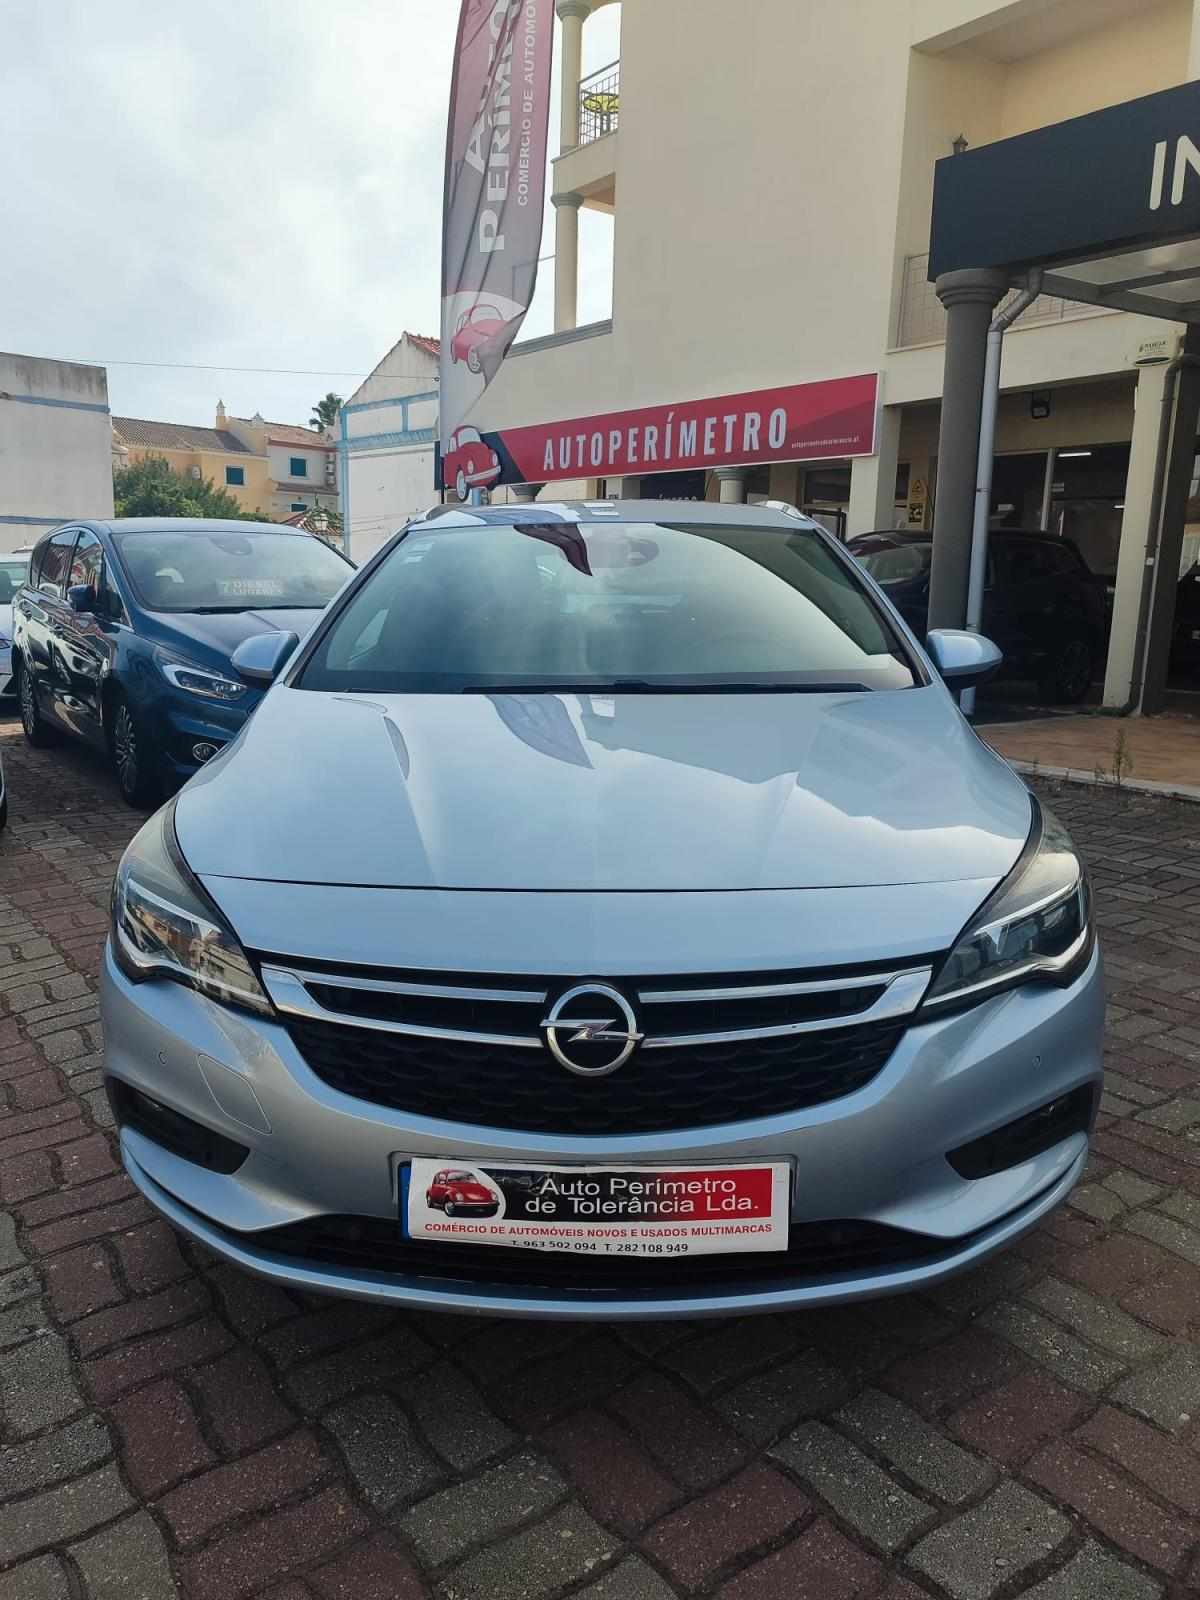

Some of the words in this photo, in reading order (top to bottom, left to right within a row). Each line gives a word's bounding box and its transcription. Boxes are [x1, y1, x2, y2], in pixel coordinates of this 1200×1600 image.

[522, 91, 534, 113] DE
[518, 119, 532, 207] COMERCIO
[543, 408, 788, 471] AUTOPERÍMETRO
[540, 1178, 600, 1196] Auto
[610, 1178, 737, 1196] Perímetro
[525, 1197, 557, 1214] de
[567, 1196, 695, 1215] Tolerância
[706, 1195, 759, 1212] Lda.
[424, 1222, 487, 1234] COMÉRCIO
[490, 1226, 505, 1235] DE
[508, 1224, 584, 1237] AUTOMÓVEIS
[587, 1228, 627, 1238] NOVOS
[630, 1228, 638, 1237] E
[640, 1227, 688, 1238] USADOS
[691, 1223, 773, 1236] MULTIMARCAS
[523, 1240, 546, 1248] 963
[574, 1242, 597, 1251] 094
[604, 1243, 614, 1251] T.
[617, 1243, 638, 1252] 282
[641, 1243, 663, 1253] 108
[665, 1243, 689, 1253] 949
